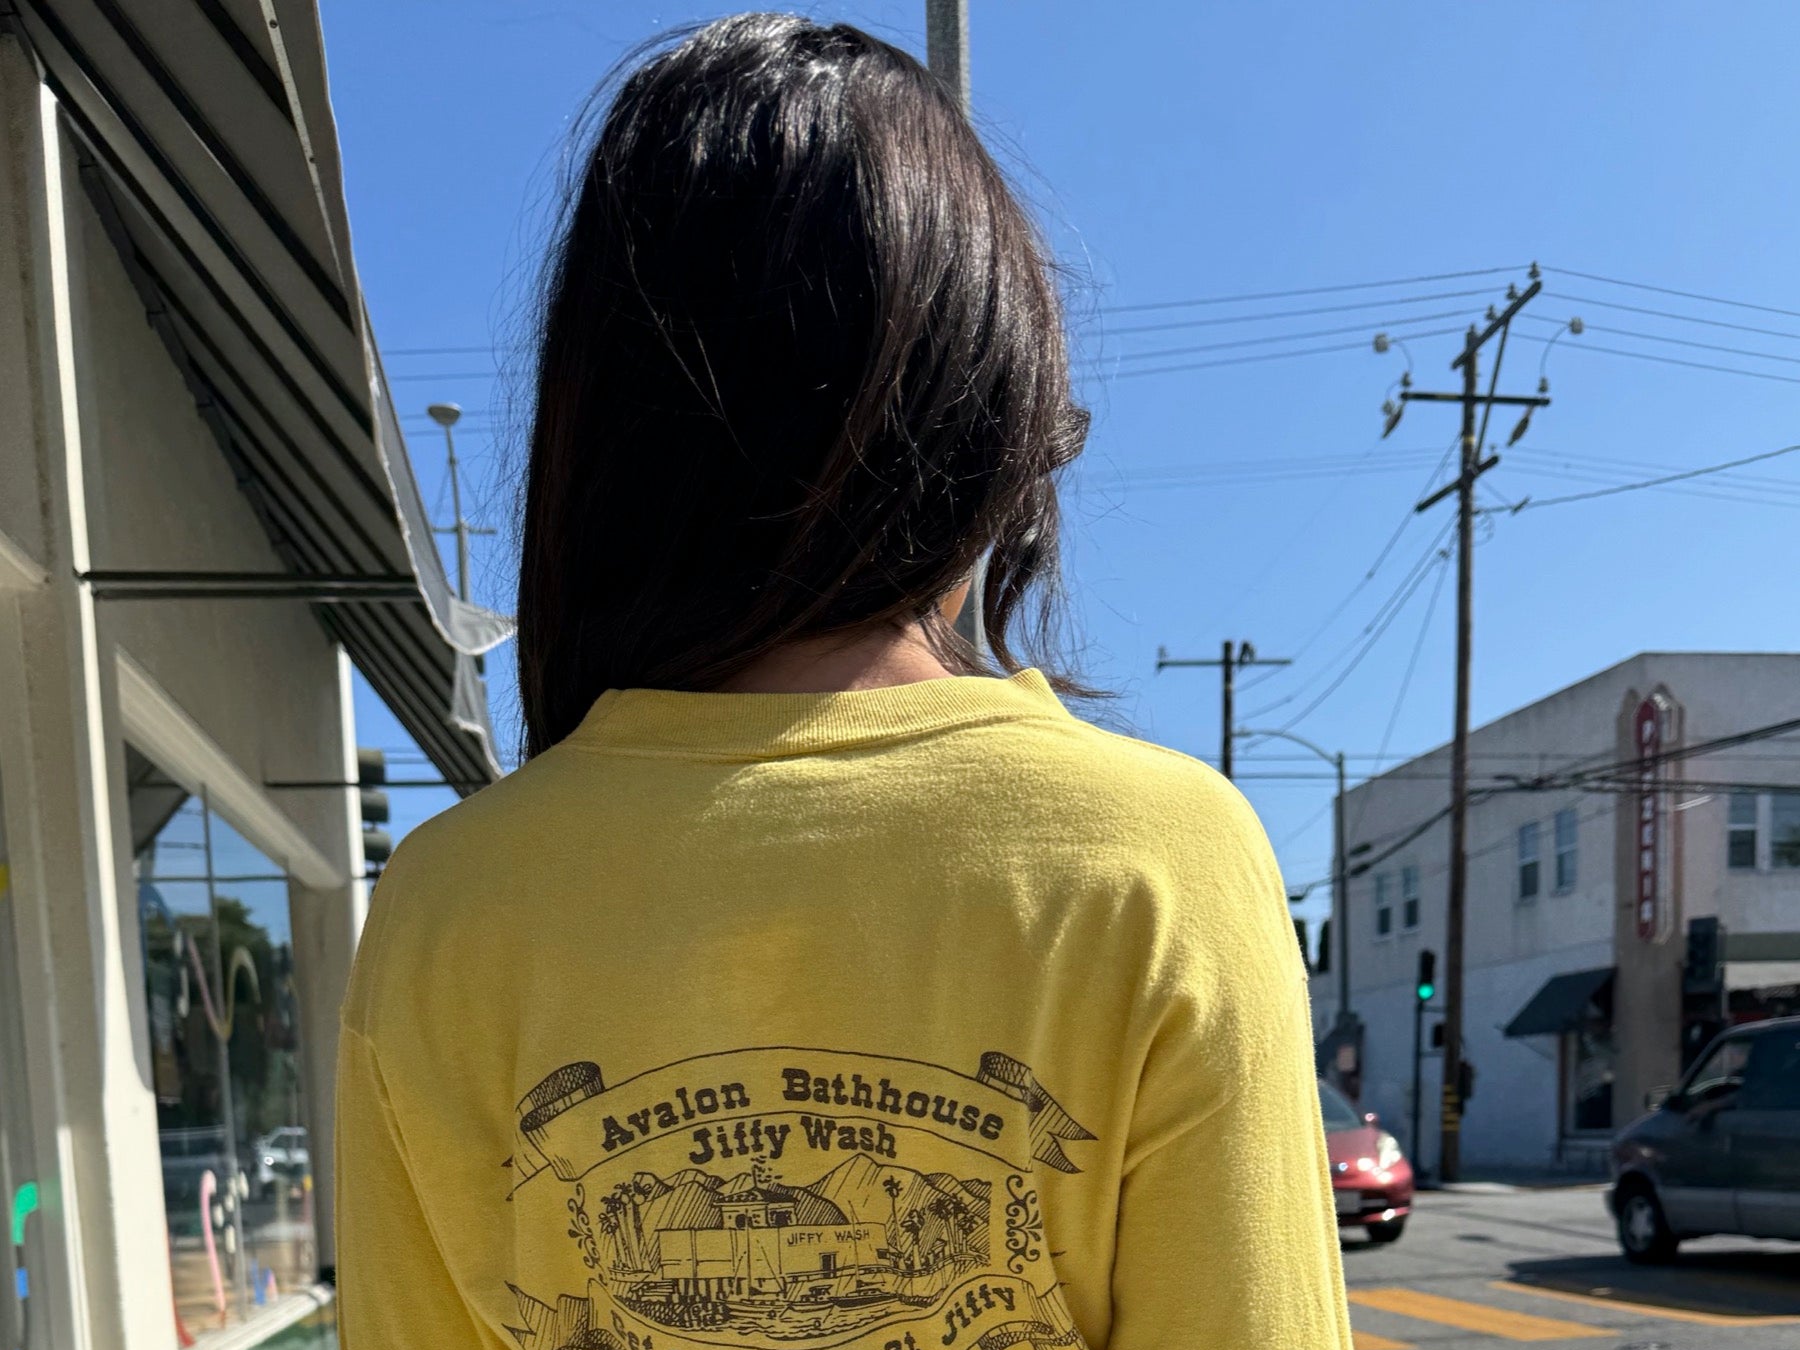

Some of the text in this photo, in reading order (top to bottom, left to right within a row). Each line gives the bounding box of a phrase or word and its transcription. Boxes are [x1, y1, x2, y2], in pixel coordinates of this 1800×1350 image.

[601, 1068, 1004, 1152] Avalon Bathhouse
[689, 1115, 897, 1165] Jiffy Wash
[787, 1229, 869, 1246] JIFFY WASH
[942, 1283, 1016, 1346] Jiffy
